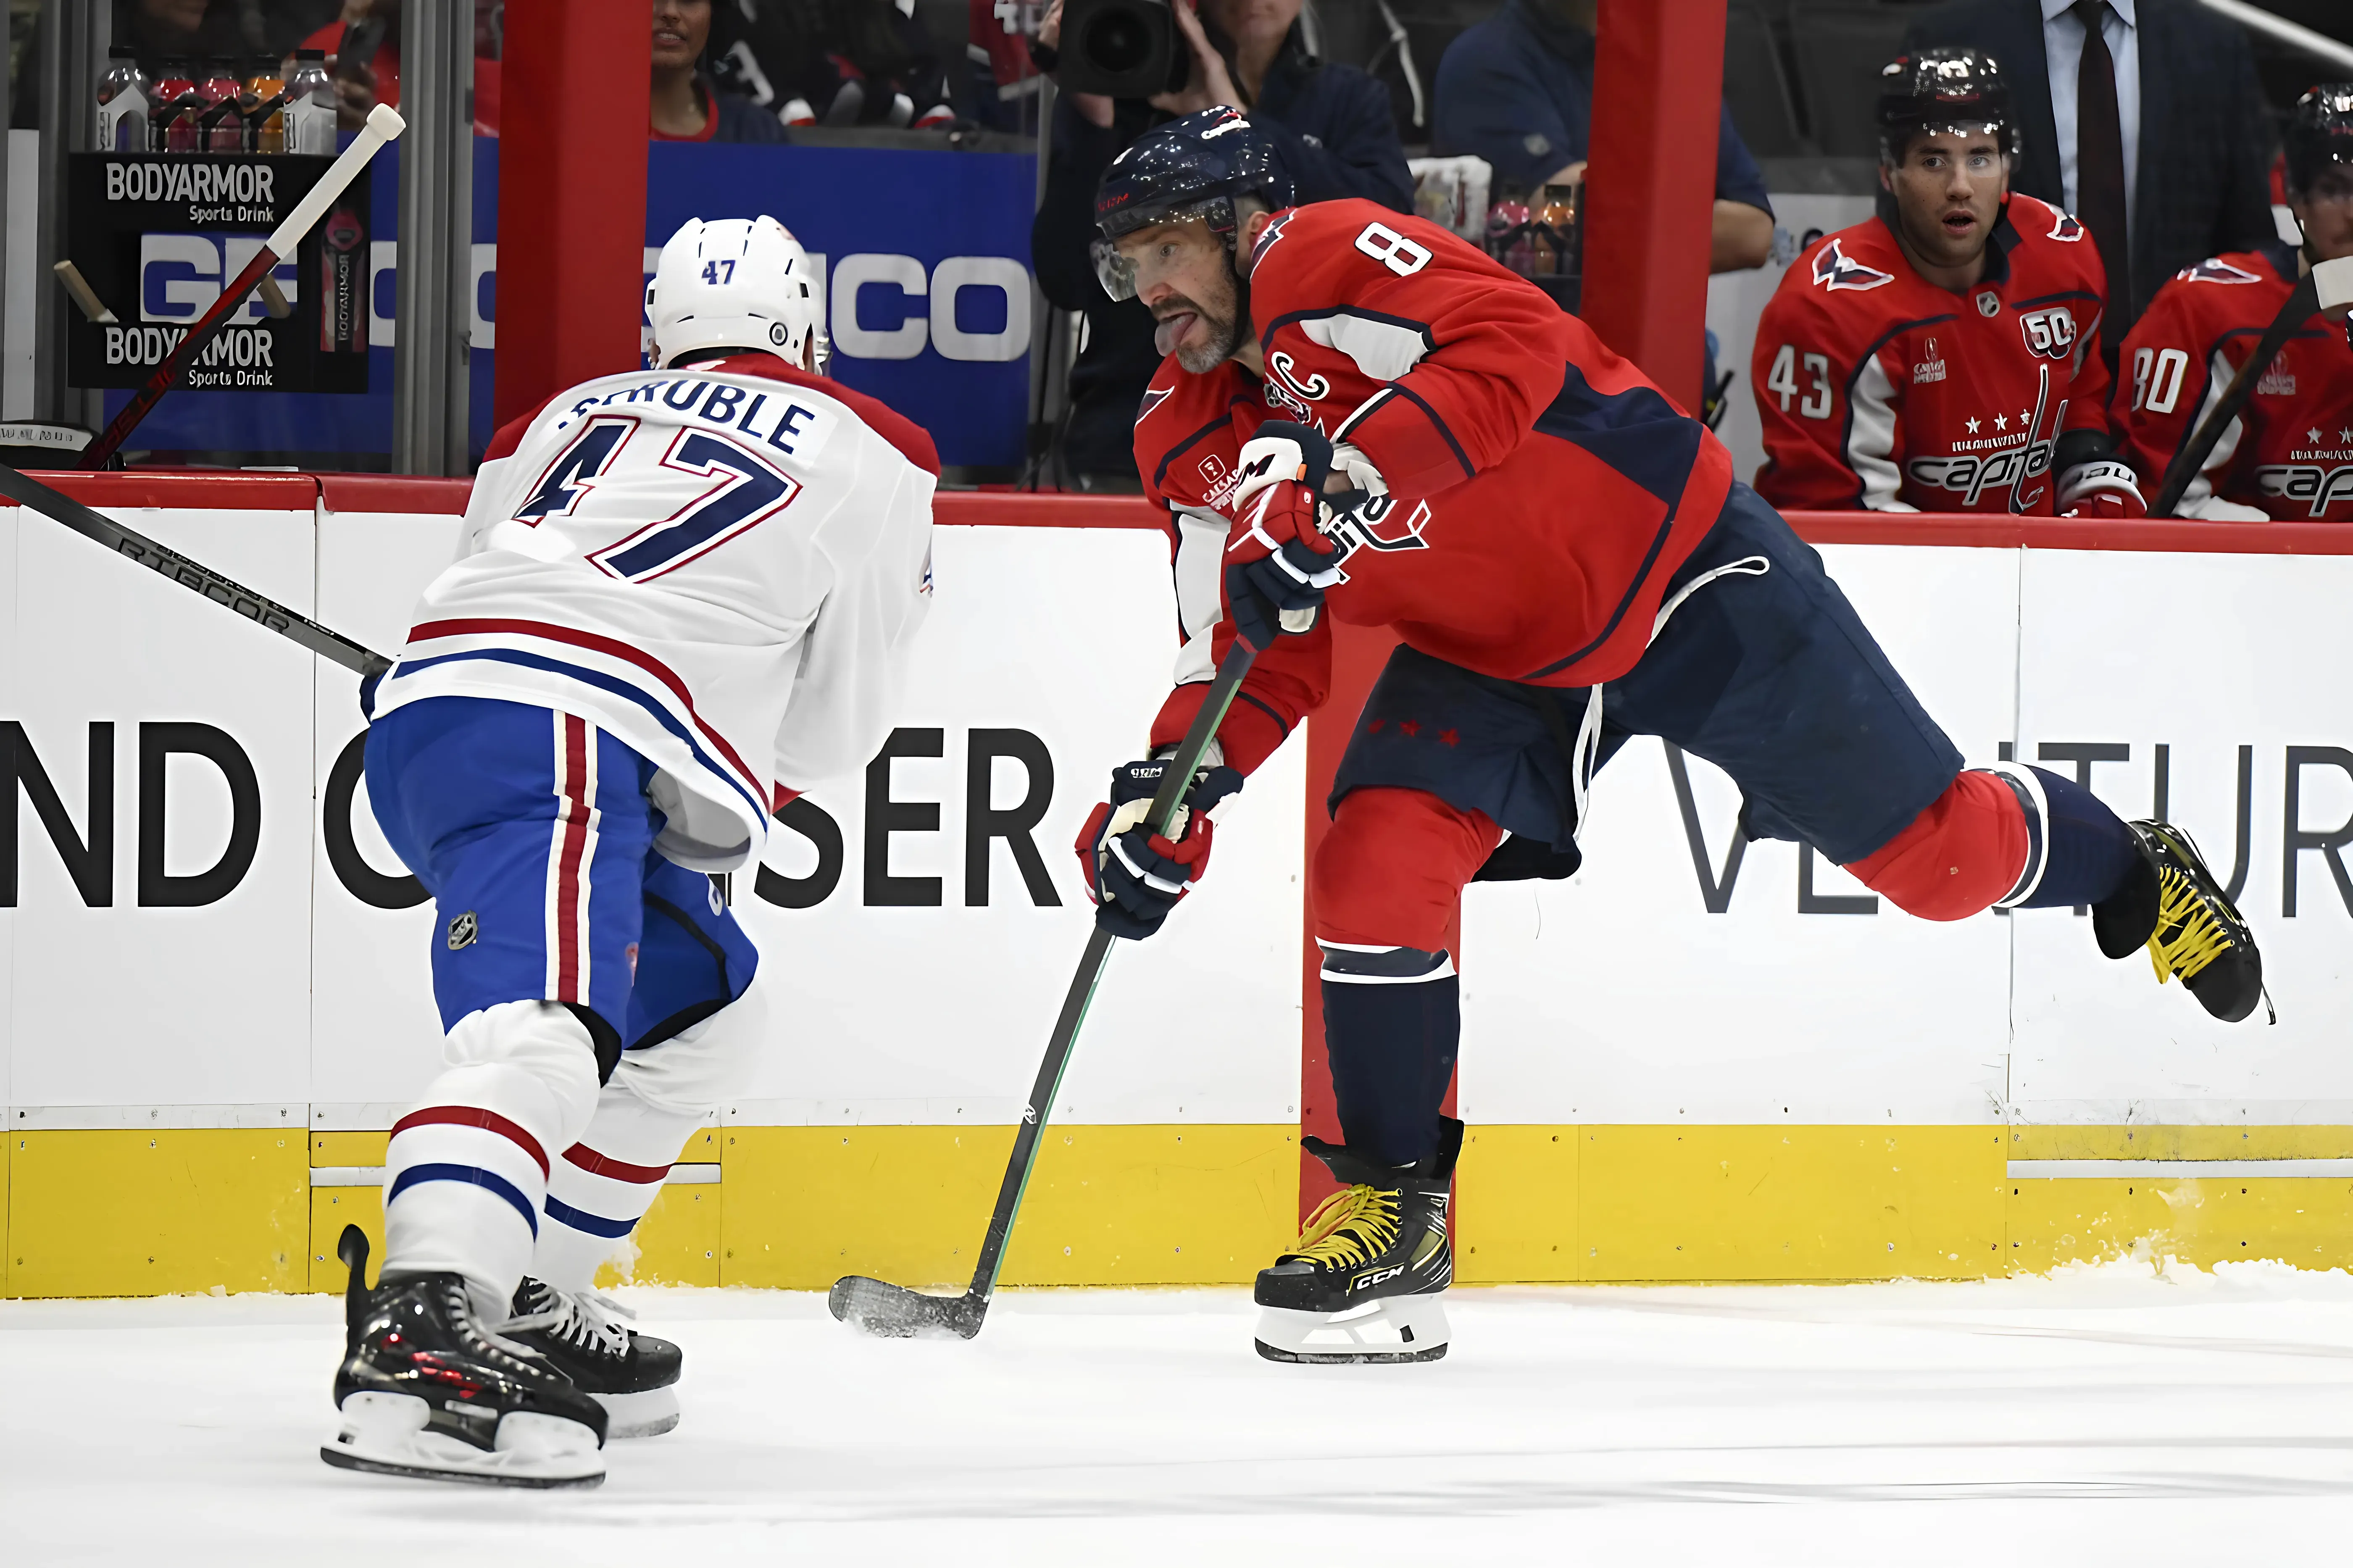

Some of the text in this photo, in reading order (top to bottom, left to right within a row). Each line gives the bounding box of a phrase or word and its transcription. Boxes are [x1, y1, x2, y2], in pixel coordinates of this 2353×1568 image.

[106, 163, 274, 203] BODYARMOR
[189, 205, 274, 224] Sports Drink
[1354, 221, 1434, 276] 8
[701, 259, 736, 285] 47
[105, 326, 273, 367] BODYMOR
[2025, 309, 2072, 351] 50
[237, 370, 273, 386] Drink
[1271, 351, 1331, 400] C
[1768, 345, 1832, 420] 43
[512, 414, 803, 585] 47
[1356, 1265, 1404, 1290] CCM
